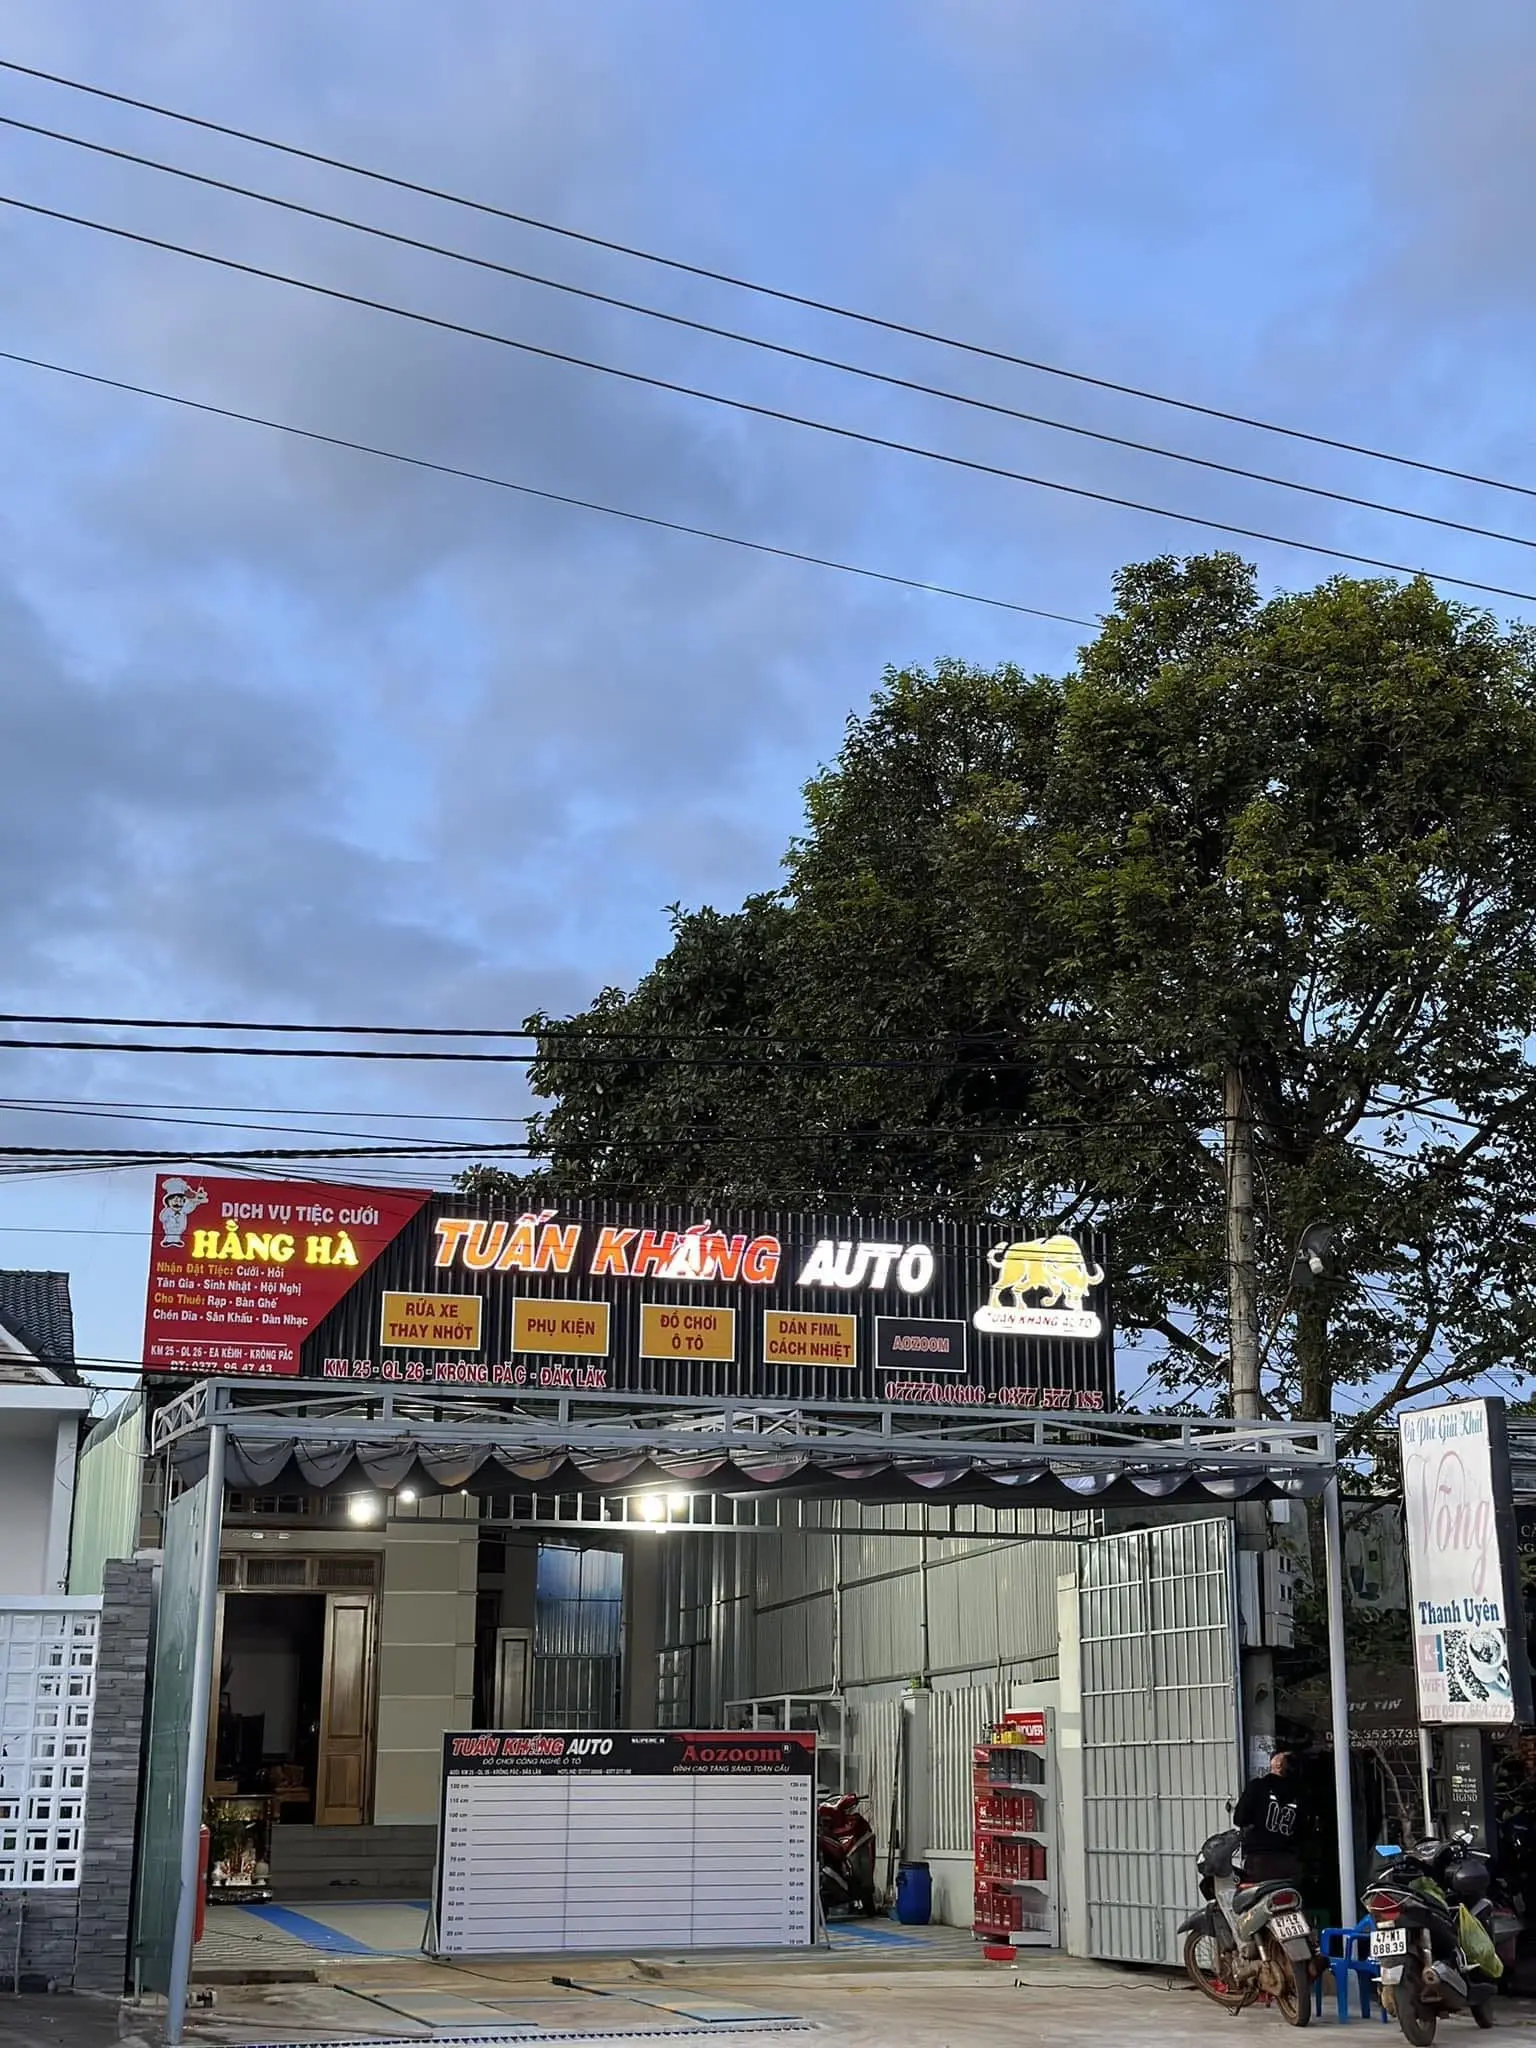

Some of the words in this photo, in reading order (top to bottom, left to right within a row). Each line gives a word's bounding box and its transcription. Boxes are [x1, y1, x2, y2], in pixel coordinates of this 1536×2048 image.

[222, 1202, 263, 1222] DỊCH
[268, 1205, 291, 1224] VỤ
[296, 1204, 334, 1226] TIỆC
[338, 1205, 379, 1225] CƯỚI
[304, 1230, 359, 1265] HÀ
[435, 1209, 581, 1273] TUẤN
[798, 1239, 934, 1293] AUTO
[157, 1262, 182, 1275] Nhận
[186, 1263, 204, 1277] Đặt
[236, 1265, 260, 1277] Cưới
[156, 1277, 175, 1288] Tân
[178, 1278, 194, 1289] Gia
[204, 1279, 225, 1290] Sinh
[228, 1280, 251, 1293] Nhật
[260, 1282, 277, 1294] Hội
[279, 1283, 301, 1296] Nghị
[154, 1292, 174, 1304] Cho
[207, 1296, 226, 1308] Rạp
[236, 1297, 254, 1307] Bàn
[405, 1298, 435, 1317] RỬA
[440, 1304, 458, 1318] XE
[153, 1309, 178, 1321] Chén
[206, 1311, 224, 1322] Sân
[283, 1314, 308, 1327] Nhạc
[660, 1311, 680, 1329] ĐỒ
[684, 1314, 717, 1331] CHƠI
[390, 1323, 428, 1338] THAY
[432, 1322, 473, 1340] NHỚT
[527, 1318, 556, 1336] PHỤ
[561, 1318, 596, 1338] KIỆN
[811, 1322, 841, 1336] FIML
[151, 1345, 163, 1356] KM
[209, 1348, 219, 1358] EA
[672, 1333, 682, 1350] Ô
[686, 1333, 704, 1351] TÔ
[769, 1339, 806, 1356] CÁCH
[810, 1342, 851, 1360] NHIỆT
[892, 1336, 950, 1353] AOZOOM
[324, 1358, 348, 1377] KM
[352, 1360, 372, 1378] 25
[382, 1361, 402, 1379] QL
[406, 1362, 424, 1380] 26
[435, 1360, 489, 1383] KRÔNG
[1418, 1599, 1461, 1625] Thanh
[1464, 1596, 1500, 1627] Uyên
[452, 1732, 500, 1756] TUẤN
[566, 1738, 613, 1755] AUTO
[682, 1744, 783, 1762] Aozoom
